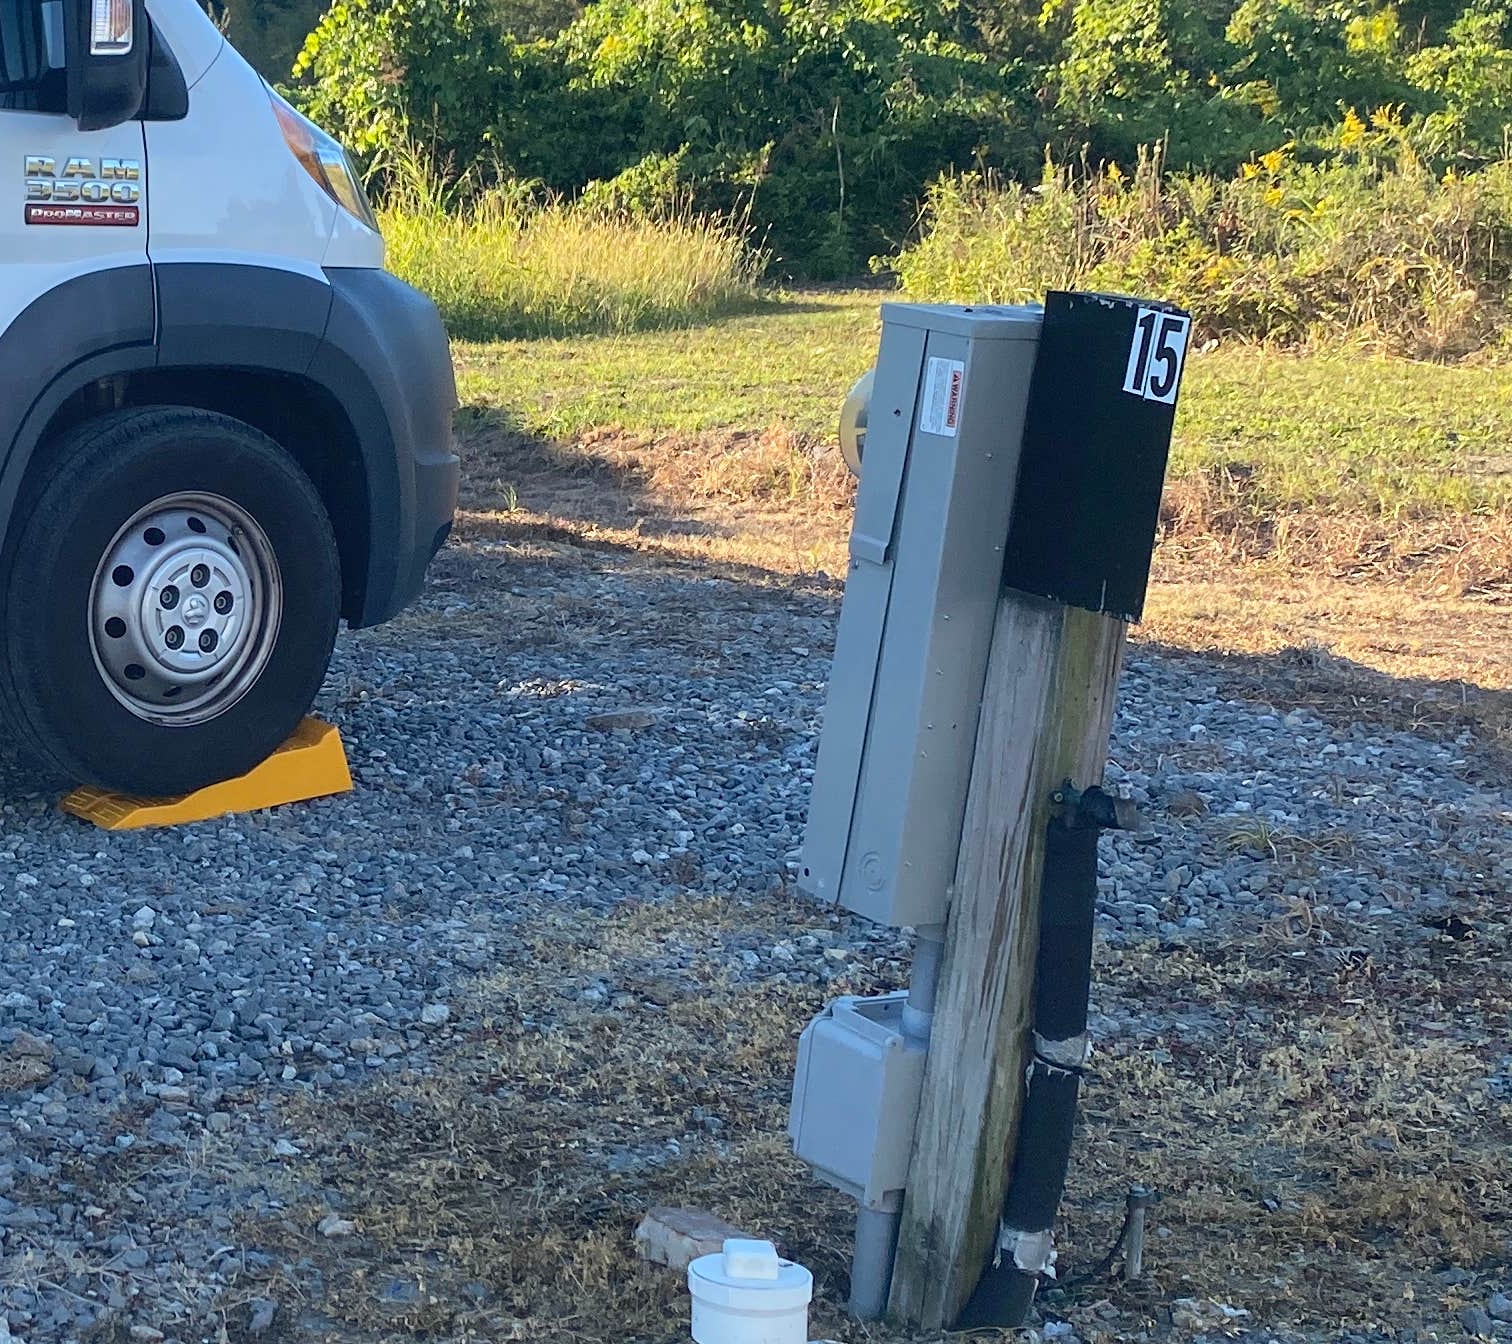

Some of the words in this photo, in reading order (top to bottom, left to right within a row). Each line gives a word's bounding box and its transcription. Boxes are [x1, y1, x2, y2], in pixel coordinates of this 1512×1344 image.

[24, 156, 140, 179] RAM
[24, 179, 140, 203] 3500
[1132, 313, 1184, 397] 15
[947, 383, 961, 425] WARNING
